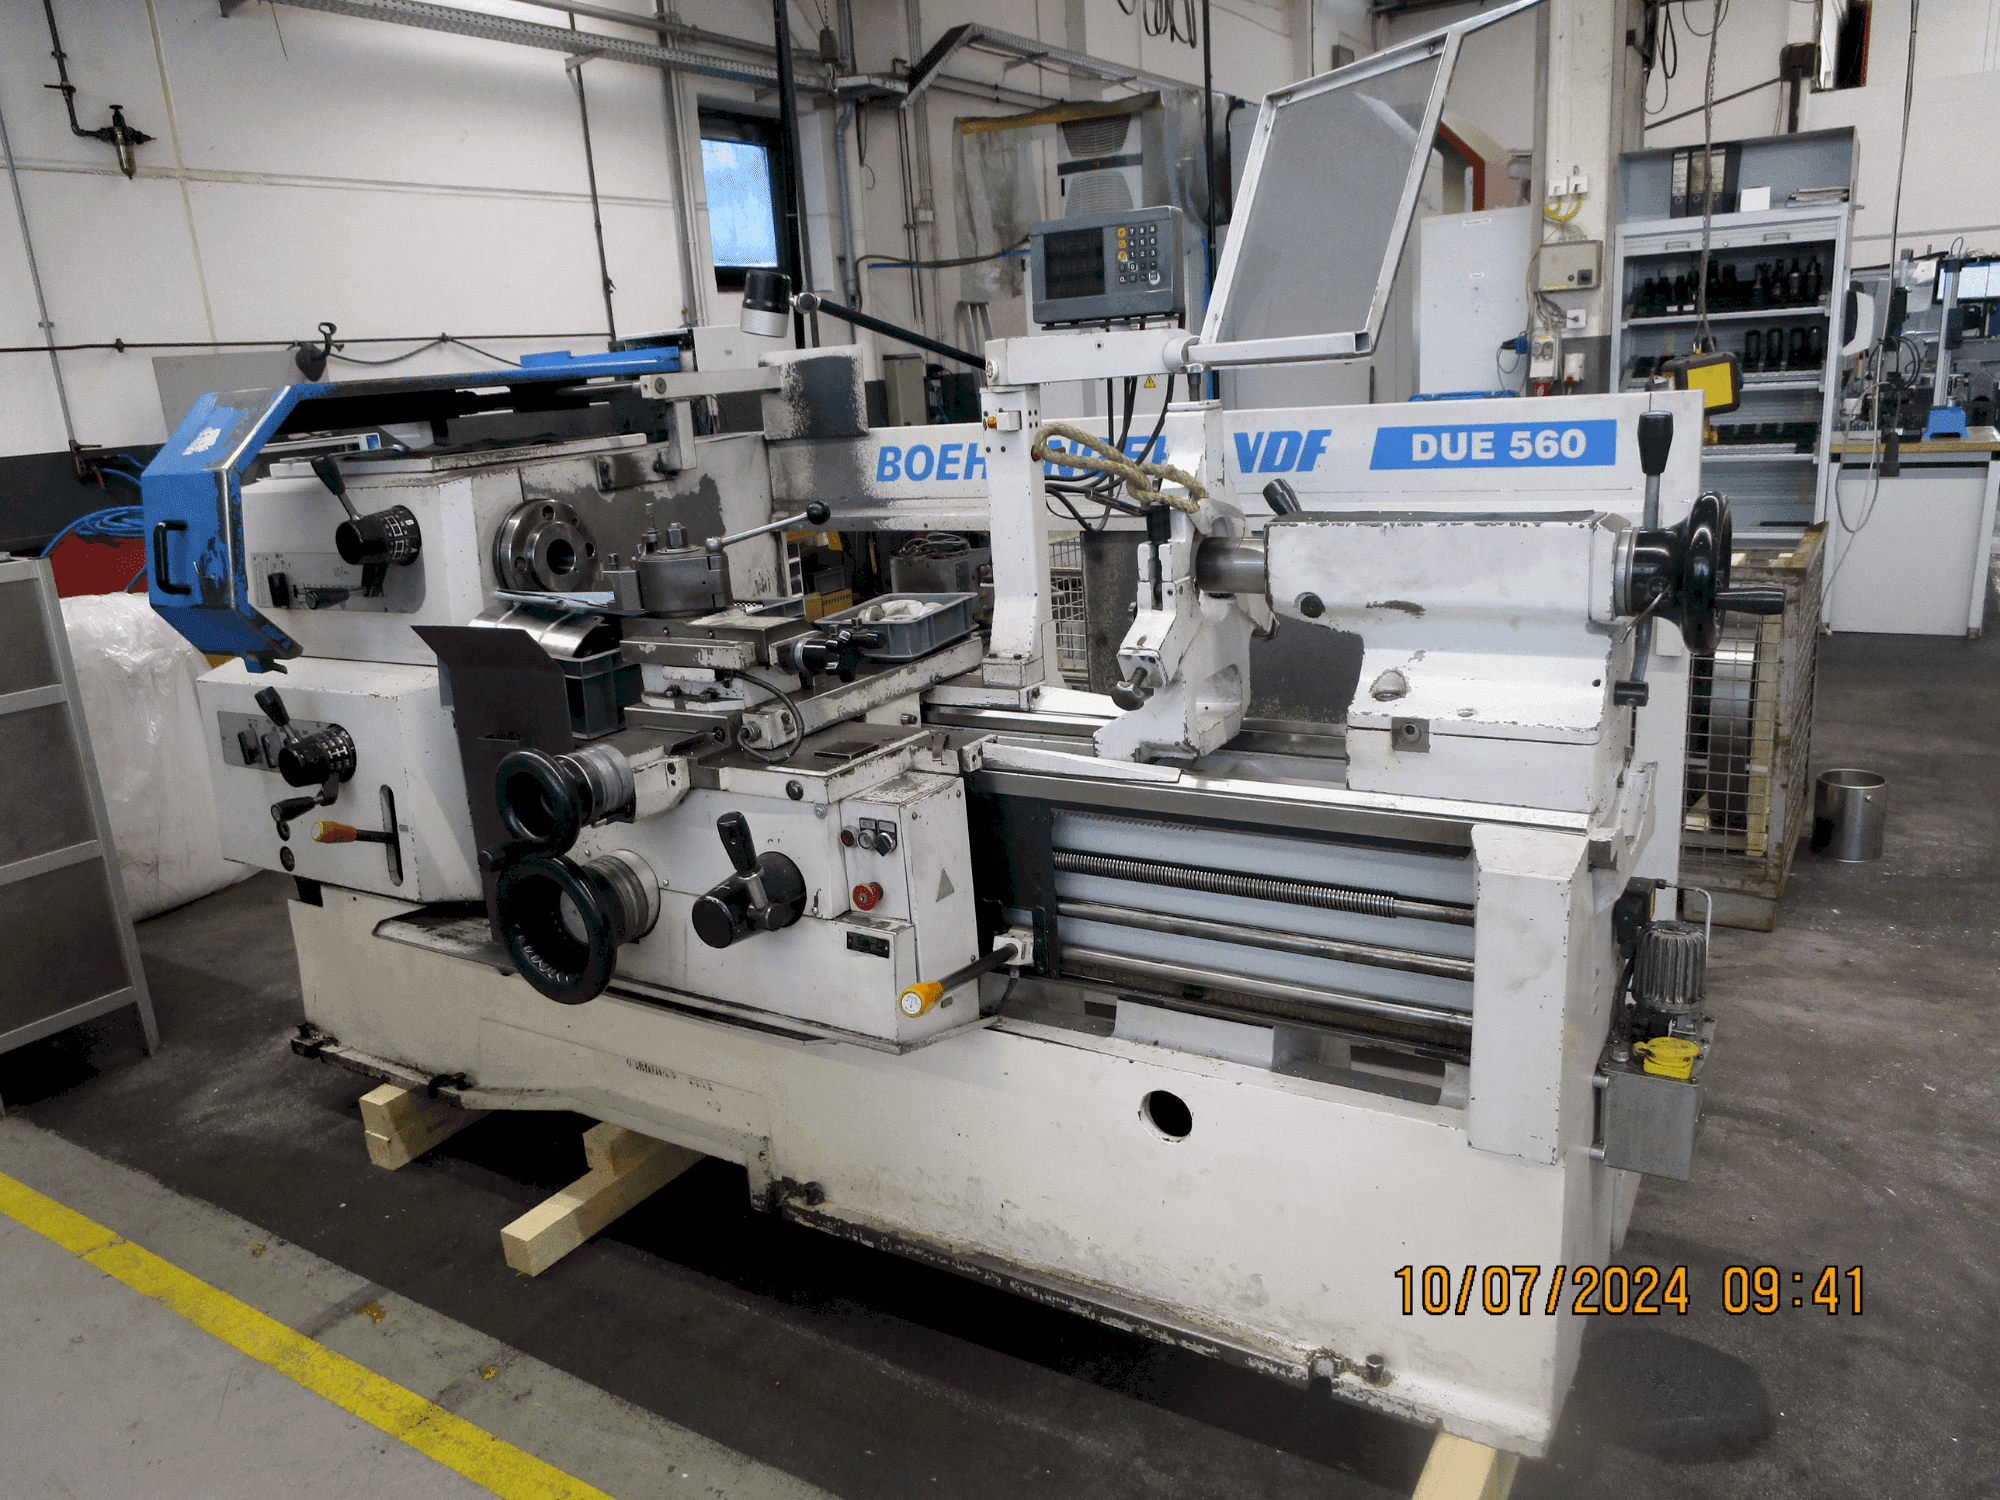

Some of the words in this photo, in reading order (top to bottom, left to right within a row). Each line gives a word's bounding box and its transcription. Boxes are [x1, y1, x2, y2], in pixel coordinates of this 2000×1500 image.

[1233, 429, 1333, 474] VDF
[1412, 431, 1495, 462] DUE
[1509, 428, 1587, 460] 560
